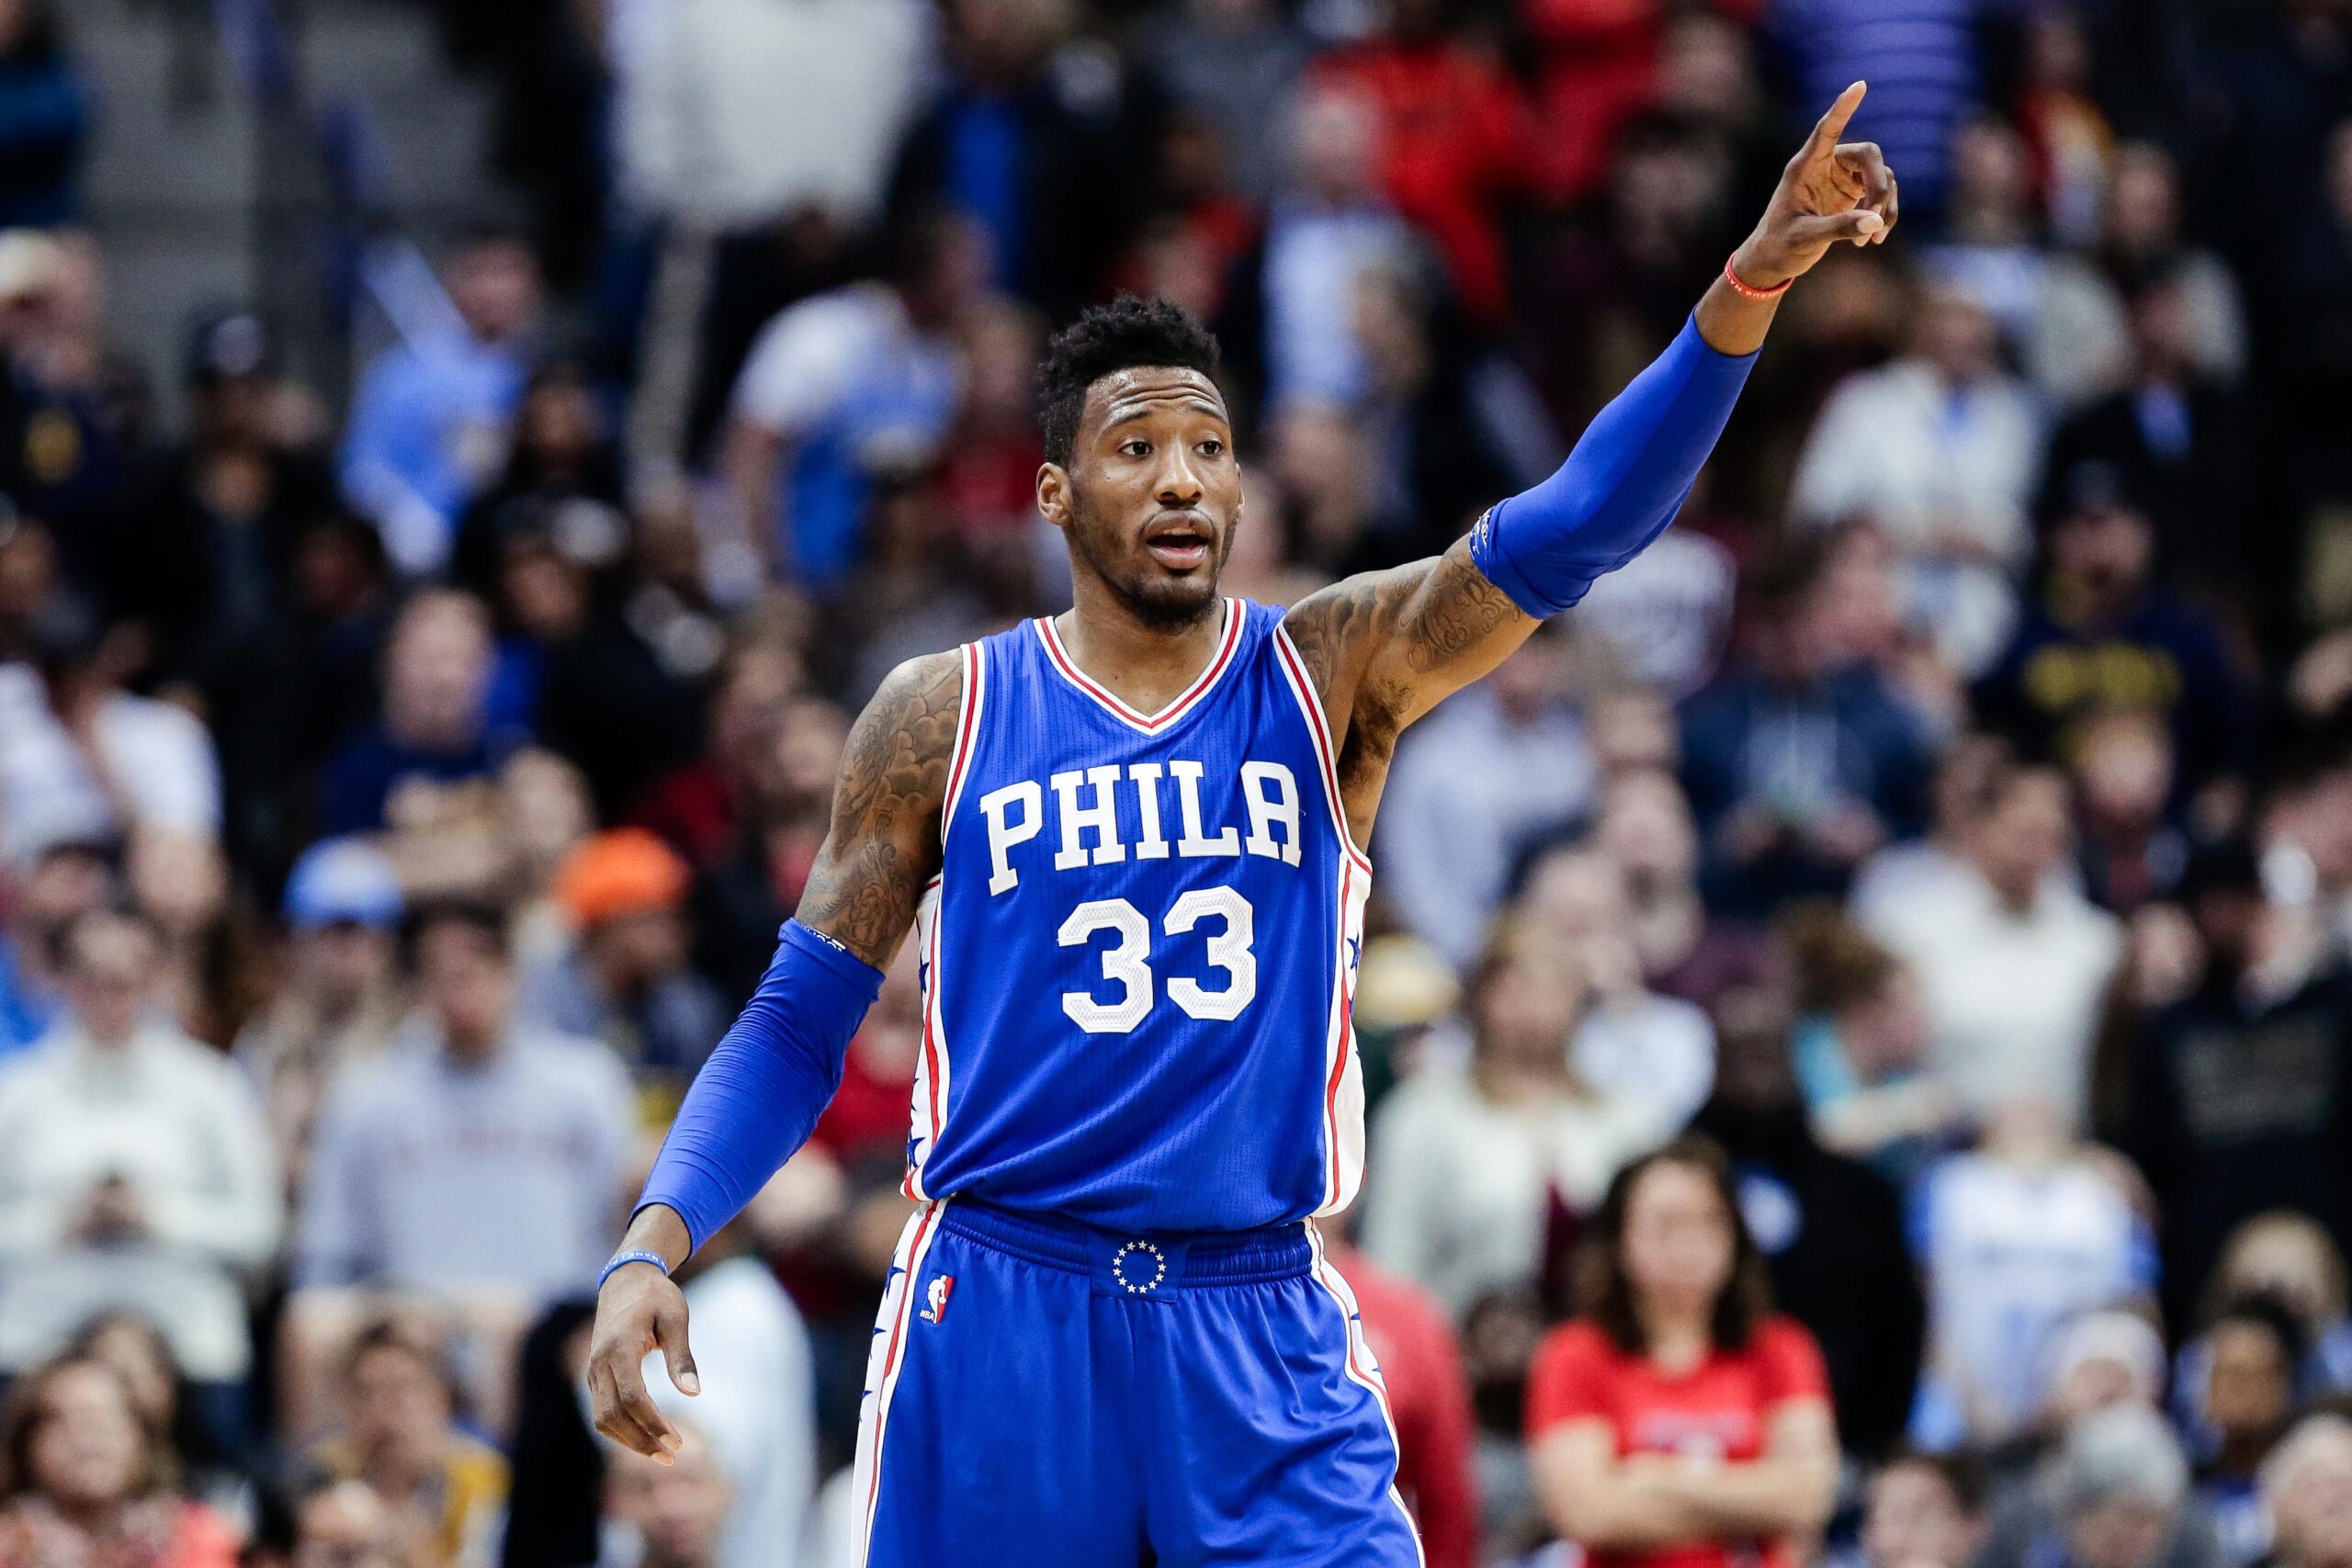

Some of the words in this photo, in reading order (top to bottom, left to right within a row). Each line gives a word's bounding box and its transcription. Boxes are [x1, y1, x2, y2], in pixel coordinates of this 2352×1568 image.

[979, 761, 1302, 897] PHILA
[1057, 885, 1257, 1033] 33
[920, 1309, 934, 1321] NBA
